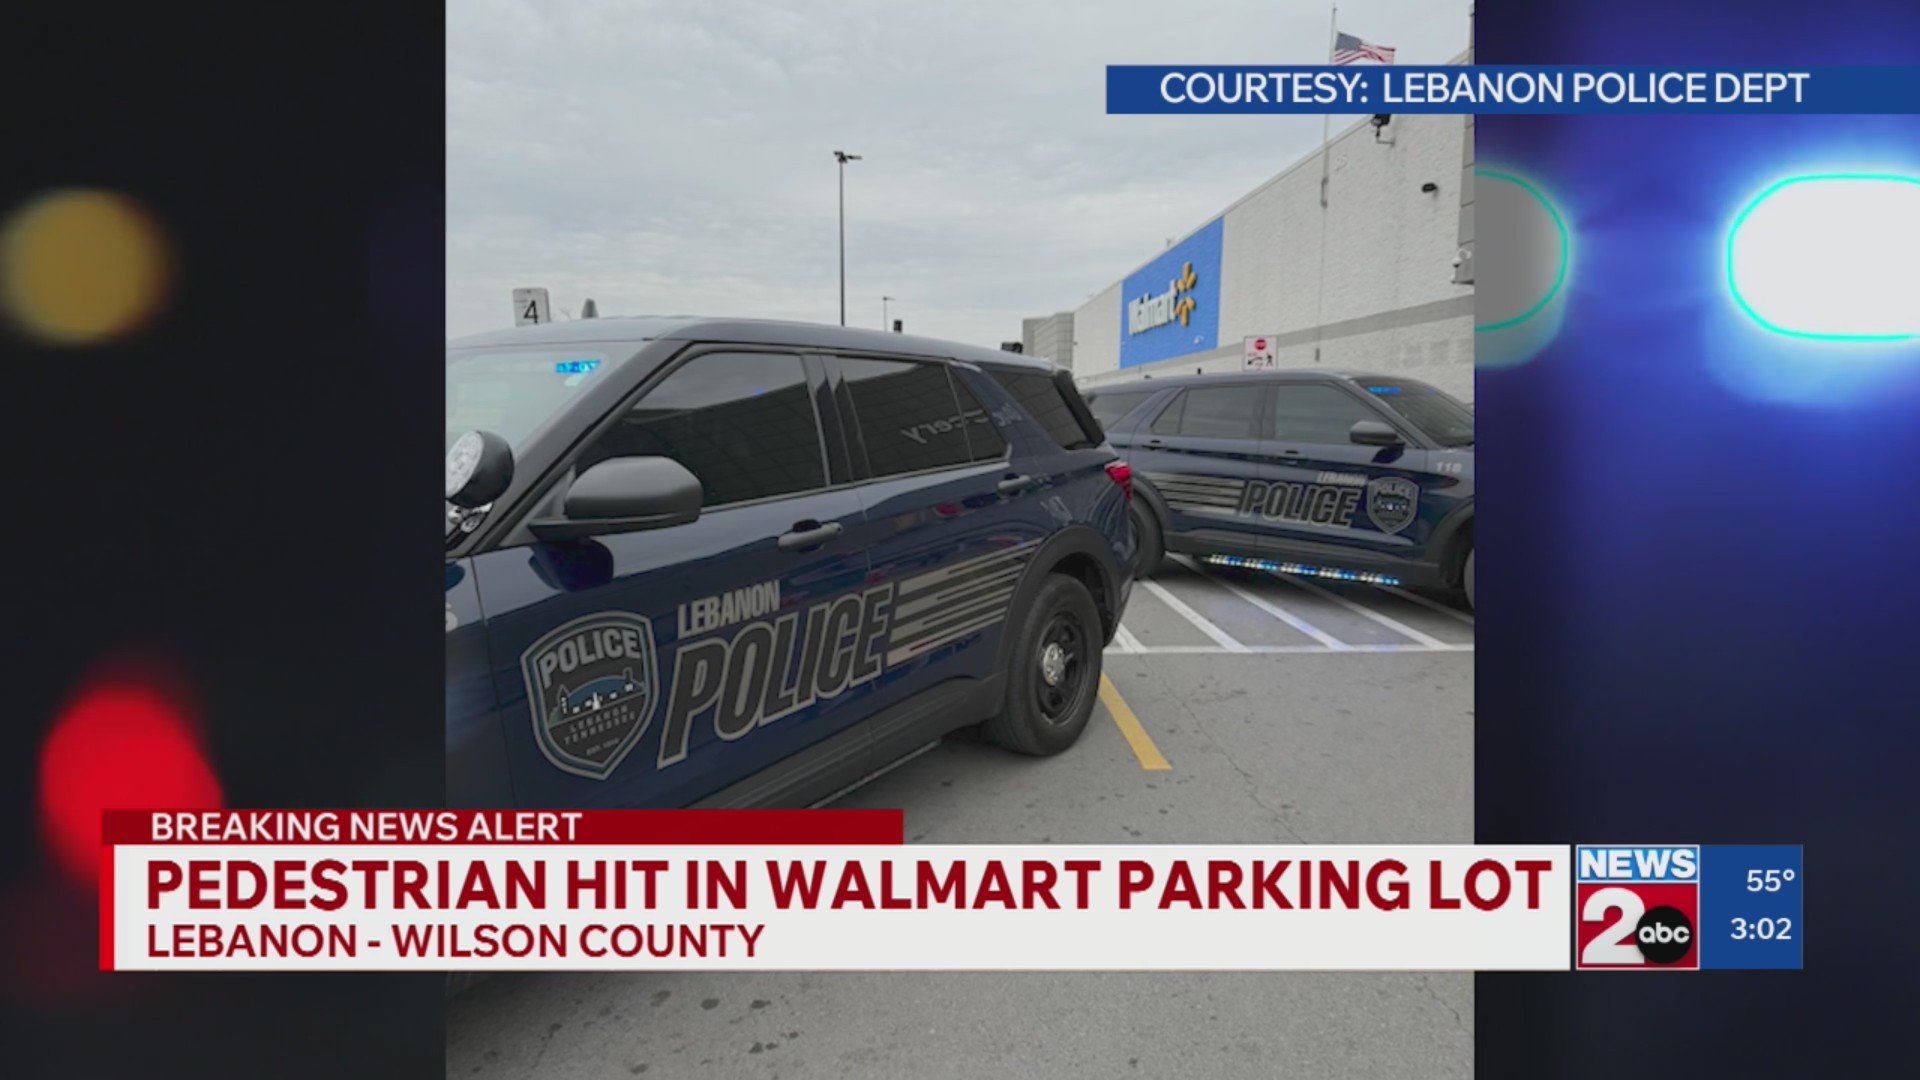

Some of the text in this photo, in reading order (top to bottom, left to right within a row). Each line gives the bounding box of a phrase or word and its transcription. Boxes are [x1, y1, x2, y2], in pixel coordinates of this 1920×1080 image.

[524, 299, 538, 325] 4
[1128, 279, 1177, 336] Walmart
[1239, 479, 1363, 529] POLICE
[678, 579, 781, 640] LEBANON
[539, 628, 642, 689] POLICE
[656, 582, 895, 770] POLICE
[564, 711, 636, 746] TENNESSEE
[570, 704, 628, 733] LEBANON
